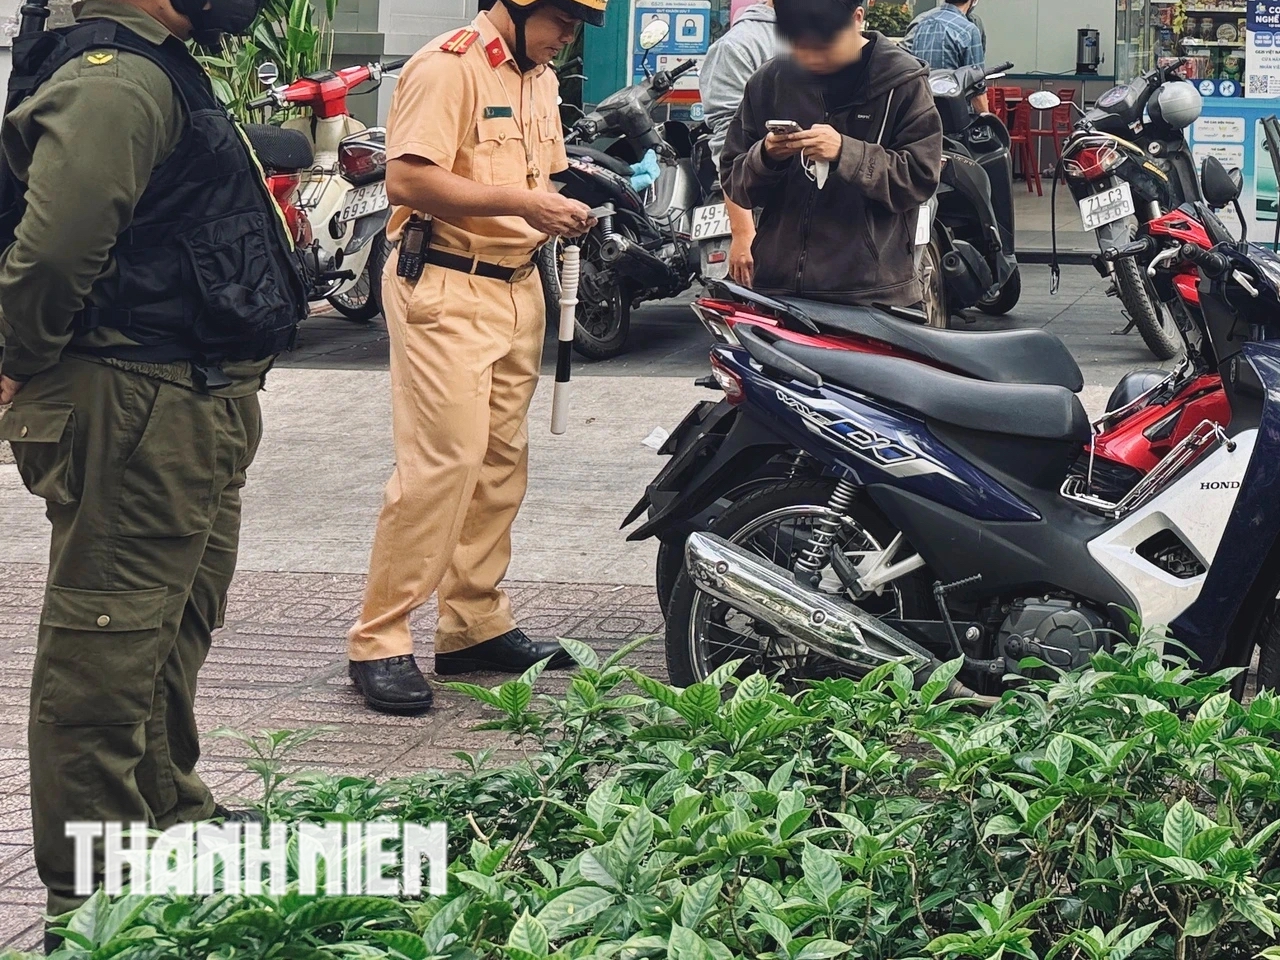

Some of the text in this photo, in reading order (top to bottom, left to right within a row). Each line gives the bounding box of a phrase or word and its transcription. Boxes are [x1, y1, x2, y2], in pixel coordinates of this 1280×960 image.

[351, 182, 385, 204] 79-Z1
[1088, 188, 1123, 213] 71-C3
[343, 194, 387, 220] 693.13
[1200, 481, 1241, 490] HOND
